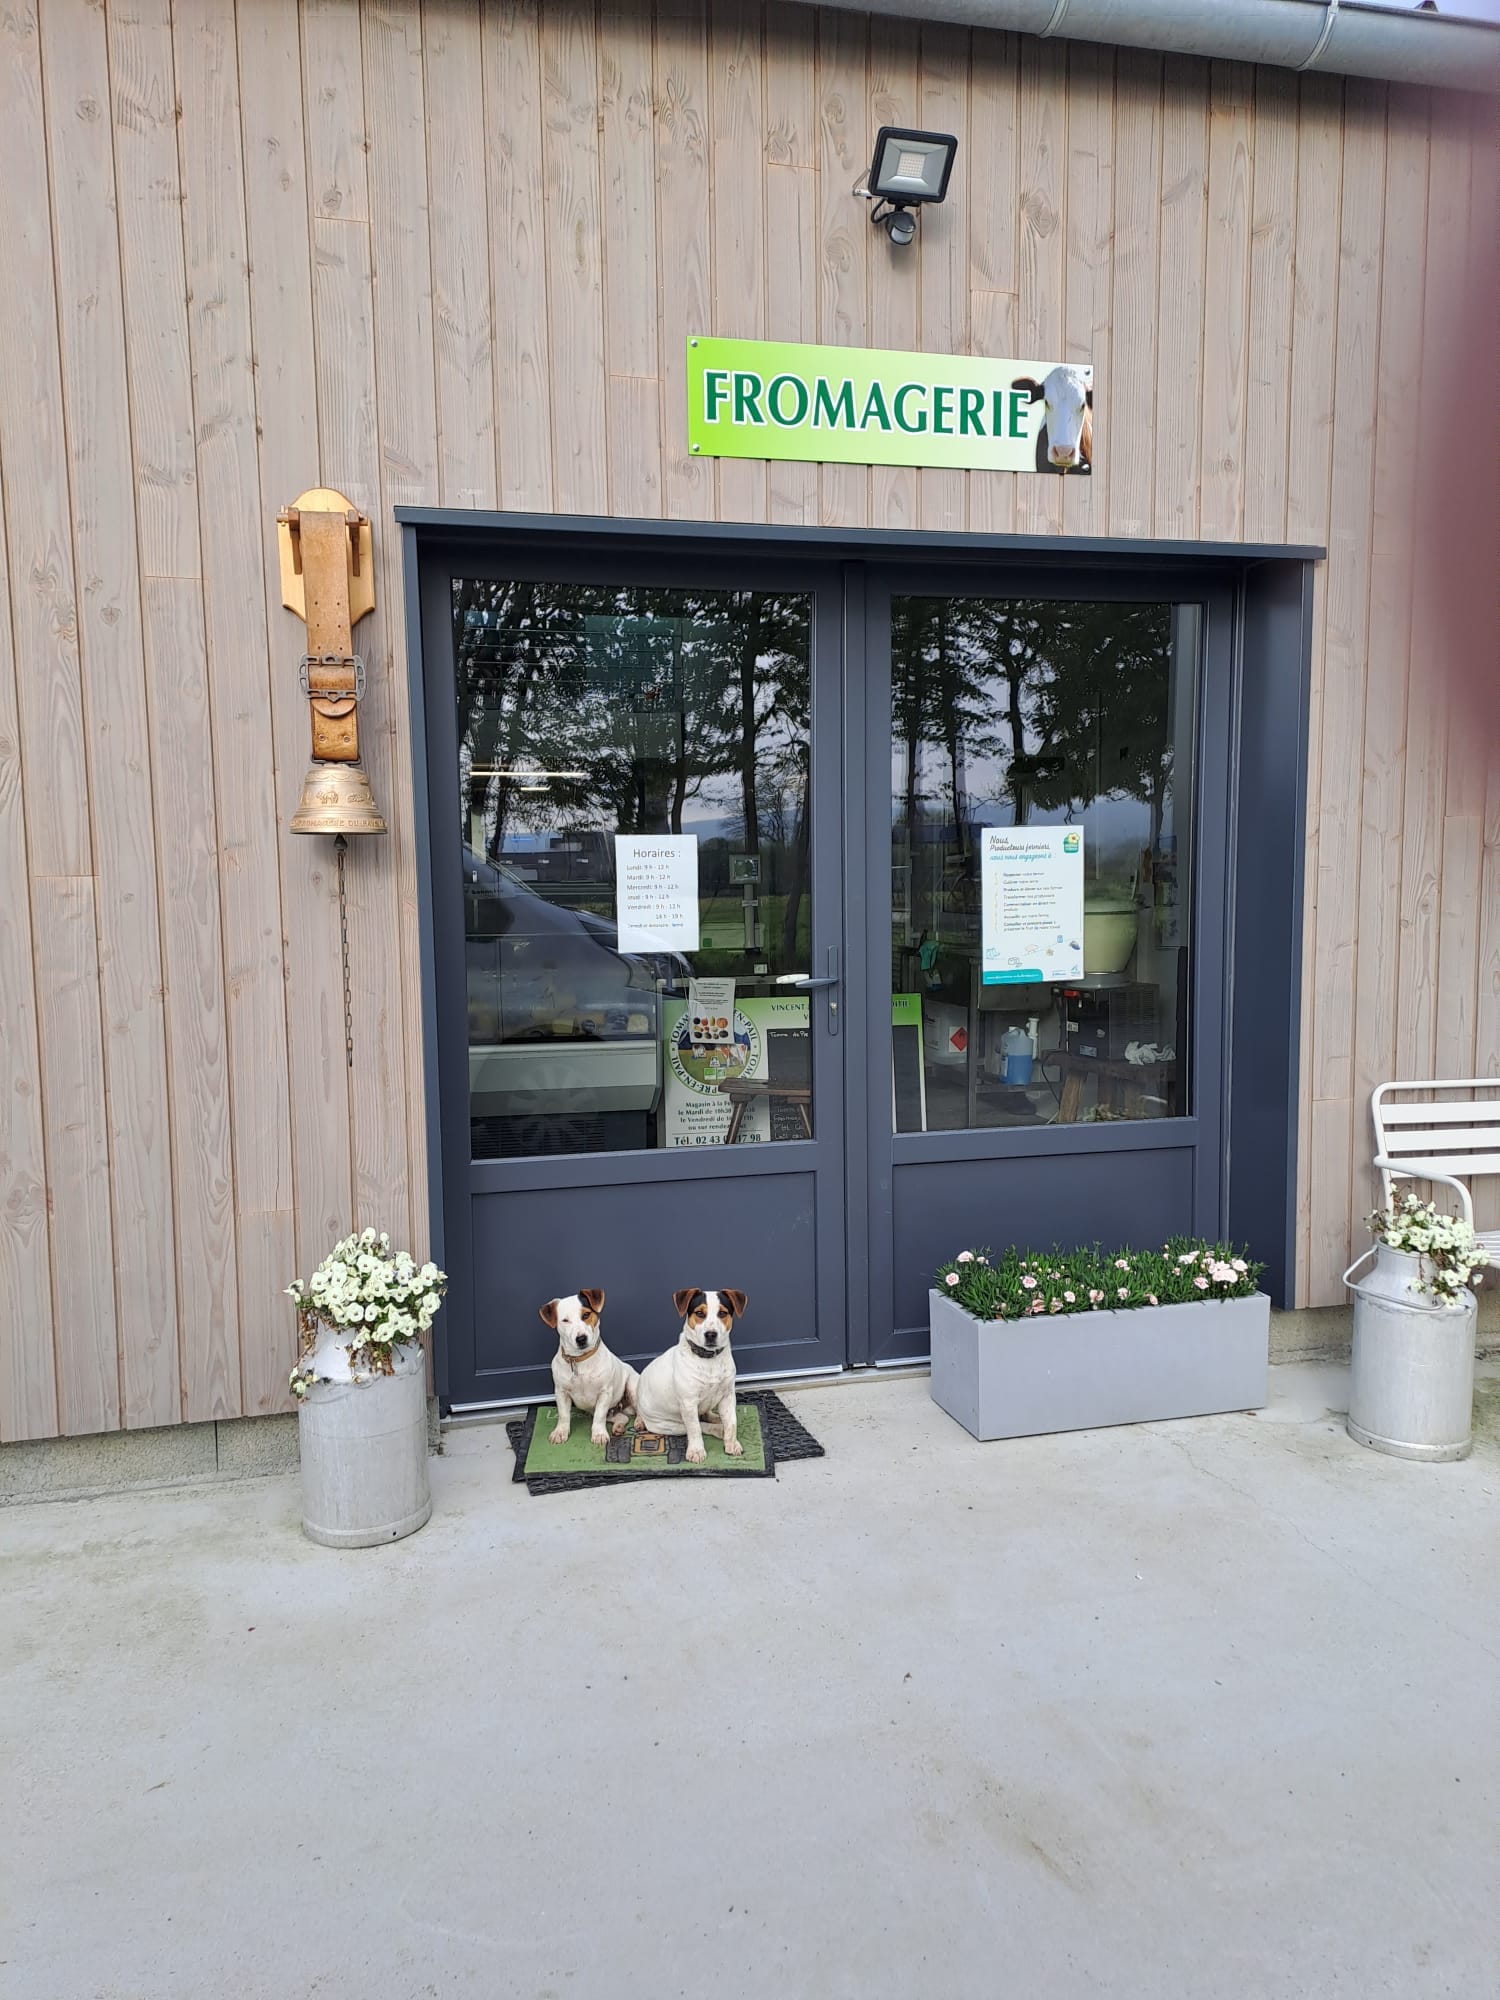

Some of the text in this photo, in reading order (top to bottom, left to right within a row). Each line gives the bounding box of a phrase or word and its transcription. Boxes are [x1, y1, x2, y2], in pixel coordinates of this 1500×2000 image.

[705, 371, 1030, 439] FROMAGERIE
[633, 848, 675, 858] Horaires
[771, 1003, 805, 1011] VINCENT
[670, 1014, 689, 1043] TOMM
[686, 1101, 711, 1109] Magasin
[687, 1115, 715, 1123] Vendredi
[674, 1136, 693, 1145] Tél.
[696, 1136, 707, 1144] 02
[709, 1135, 720, 1143] 43
[750, 1133, 761, 1142] 98
